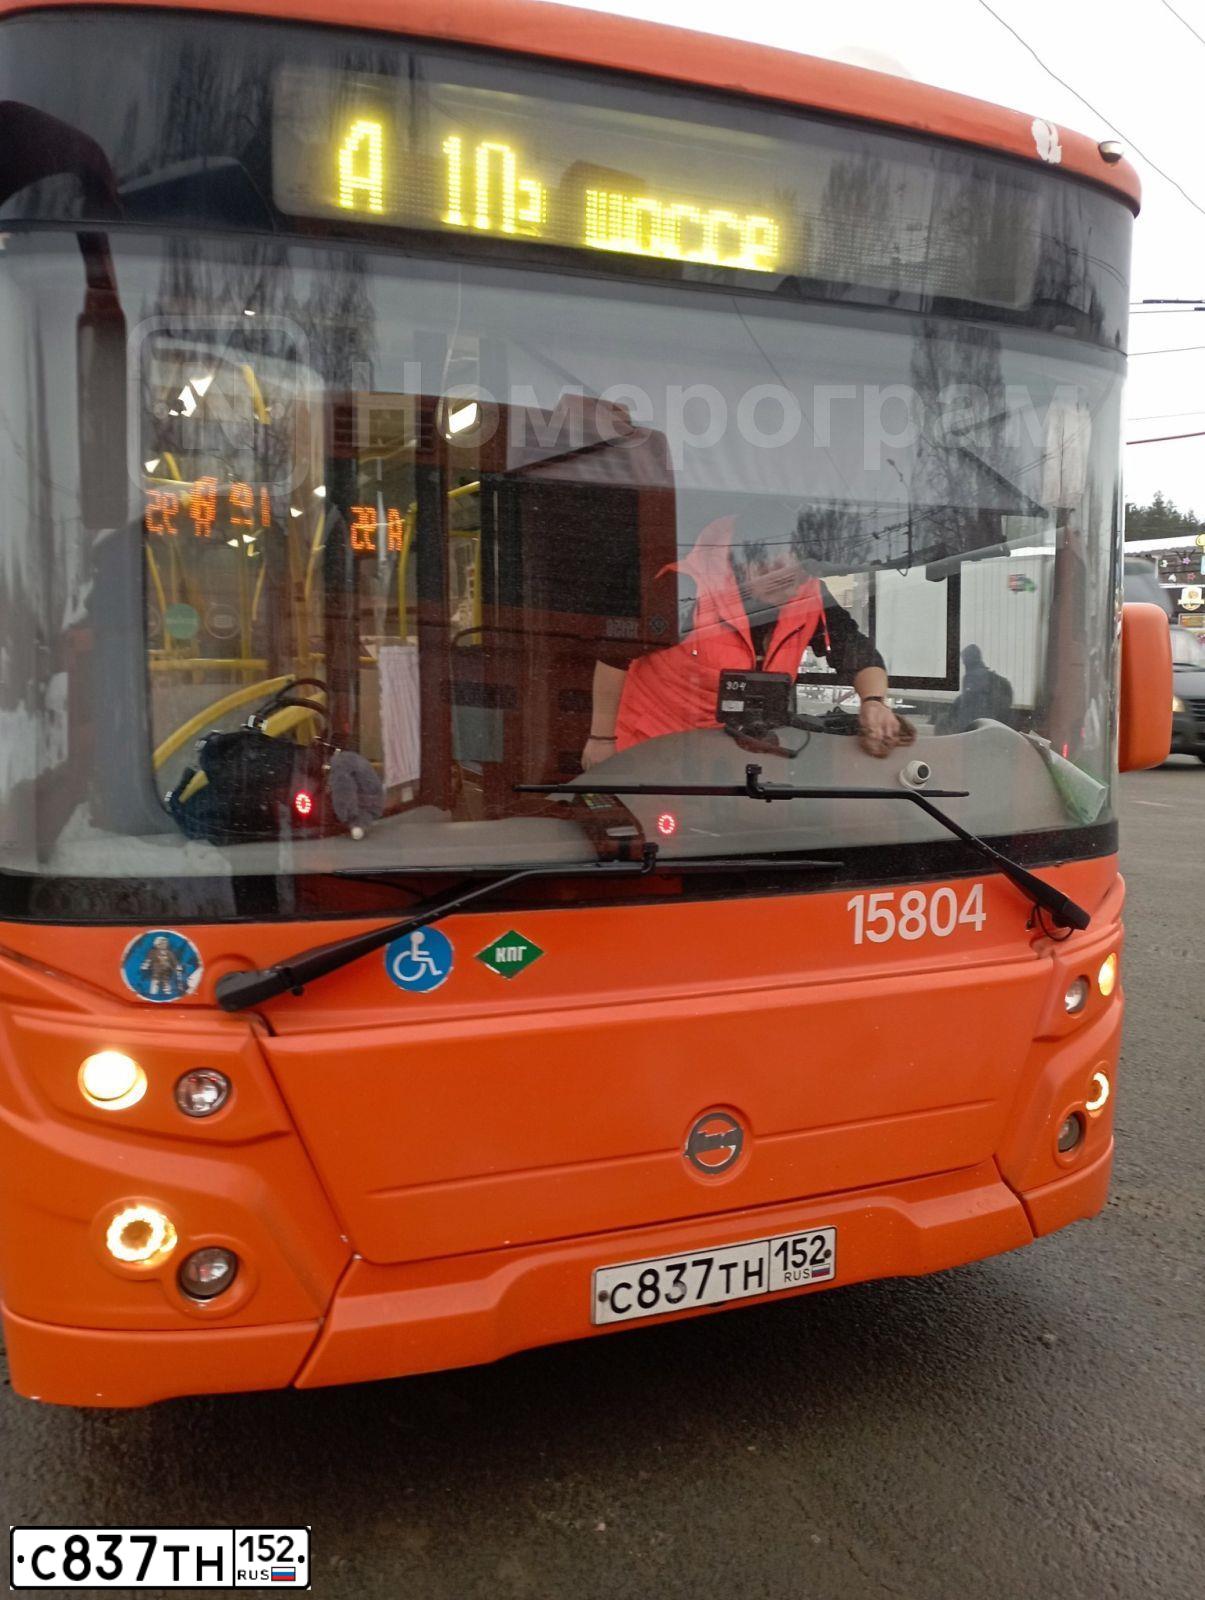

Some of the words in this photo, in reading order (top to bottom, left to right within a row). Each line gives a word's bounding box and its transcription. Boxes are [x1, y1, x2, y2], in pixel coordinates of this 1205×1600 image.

[847, 883, 987, 945] 15804
[495, 945, 528, 963] КПГ
[773, 1234, 827, 1272] 152
[783, 1268, 810, 1283] RUS
